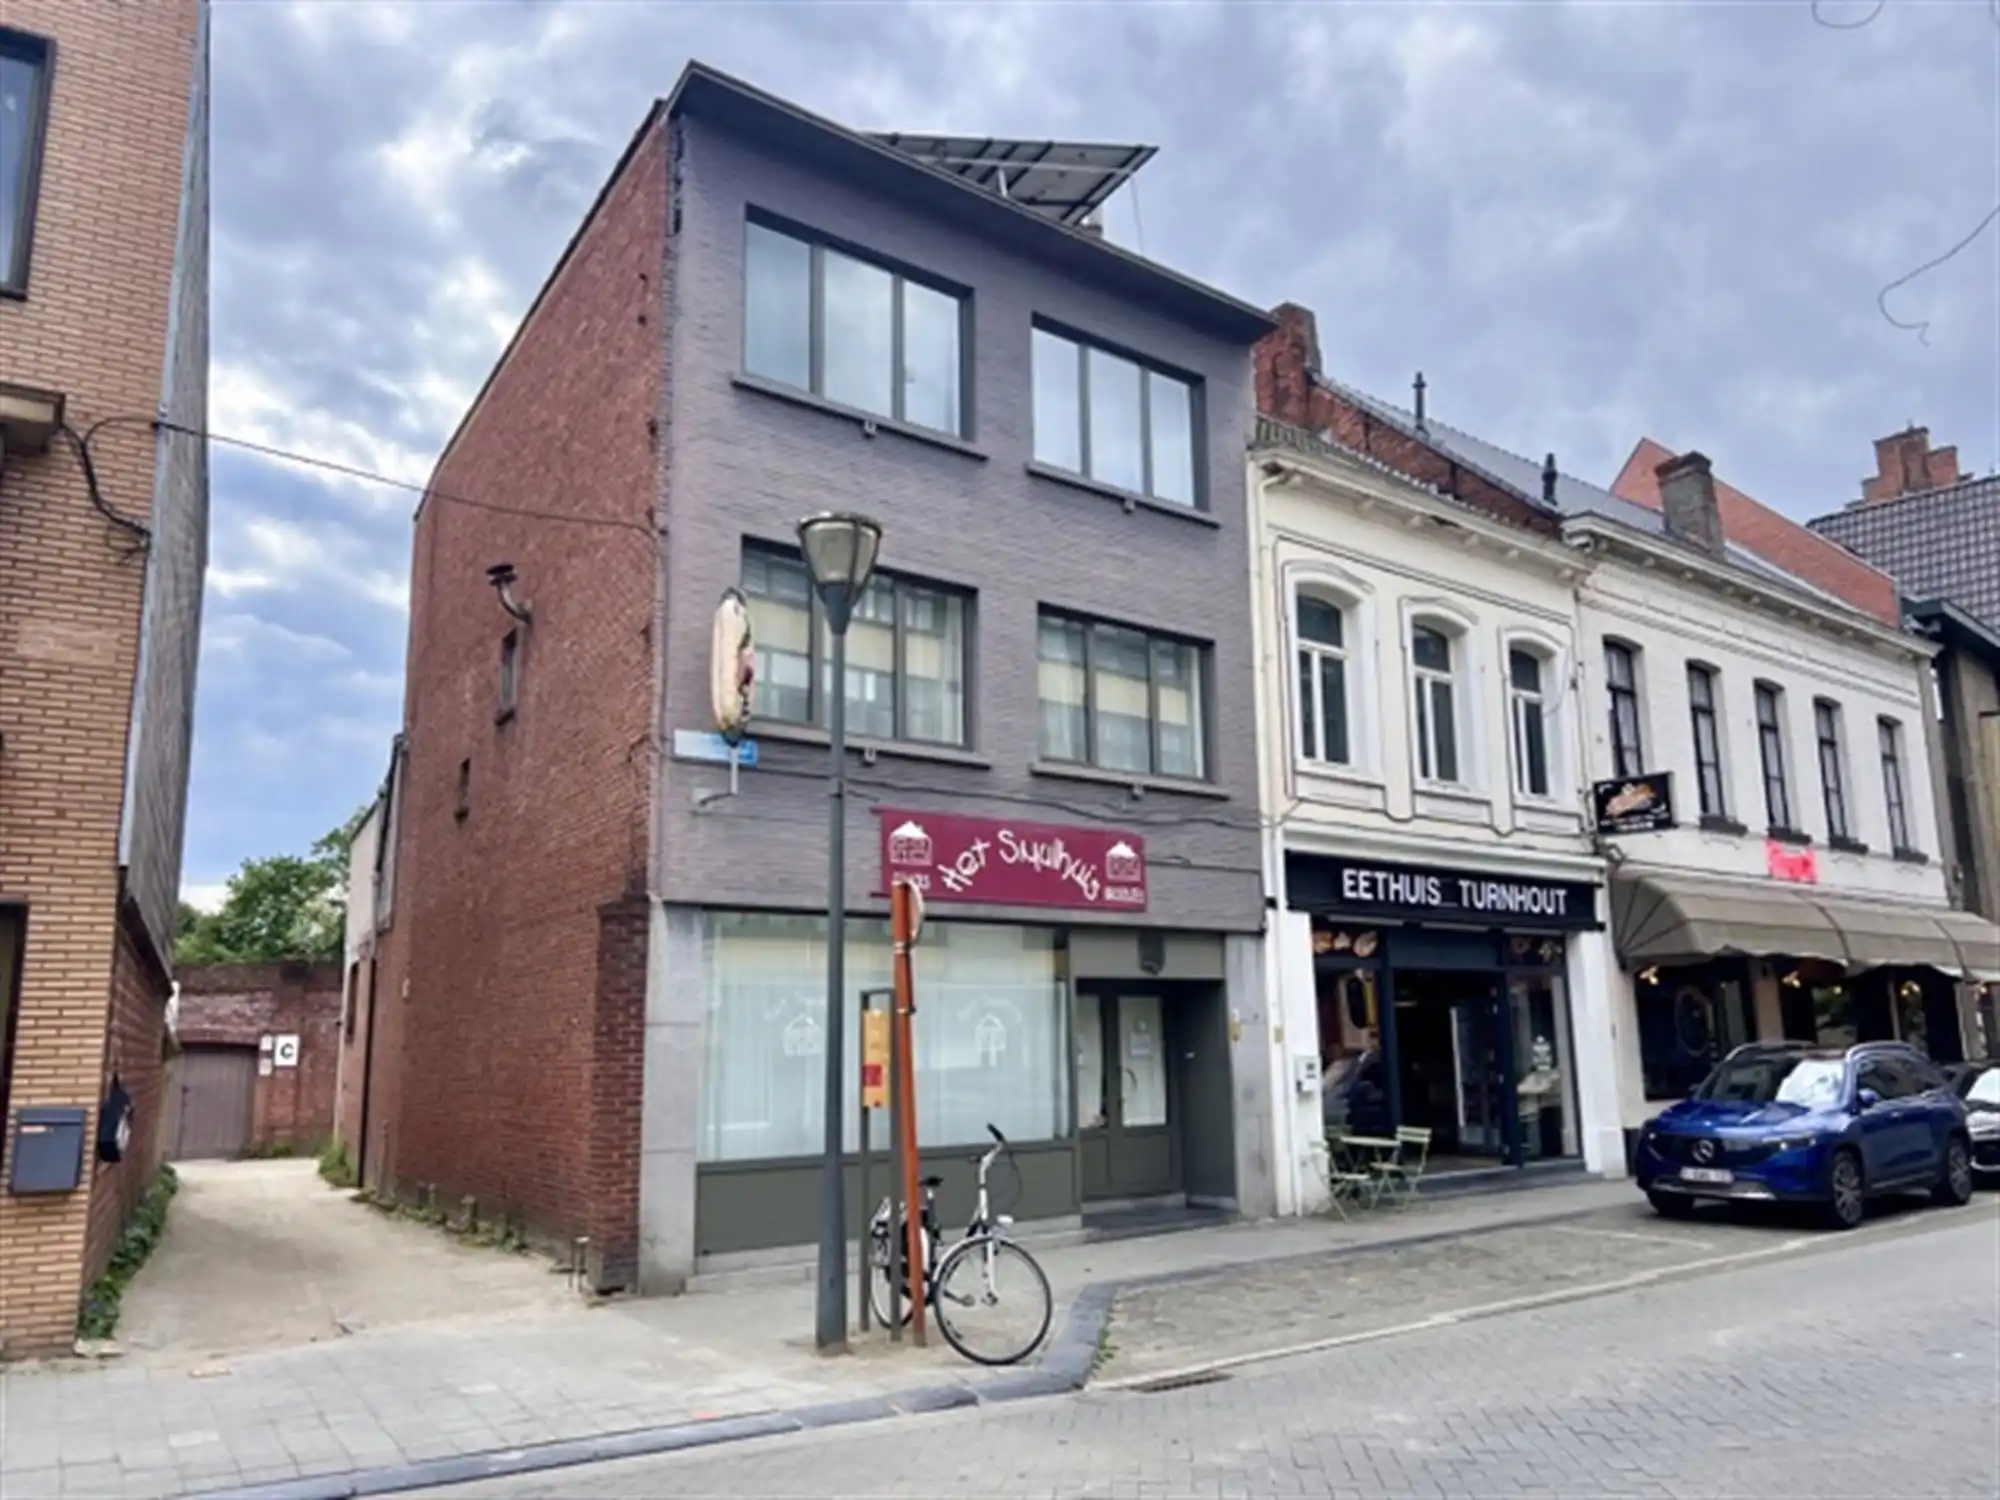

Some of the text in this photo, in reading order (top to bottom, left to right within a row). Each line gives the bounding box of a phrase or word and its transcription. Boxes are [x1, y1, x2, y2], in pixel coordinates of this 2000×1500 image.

[1342, 868, 1567, 915] EETHUIS TURNHOUT
[280, 1043, 293, 1059] C
